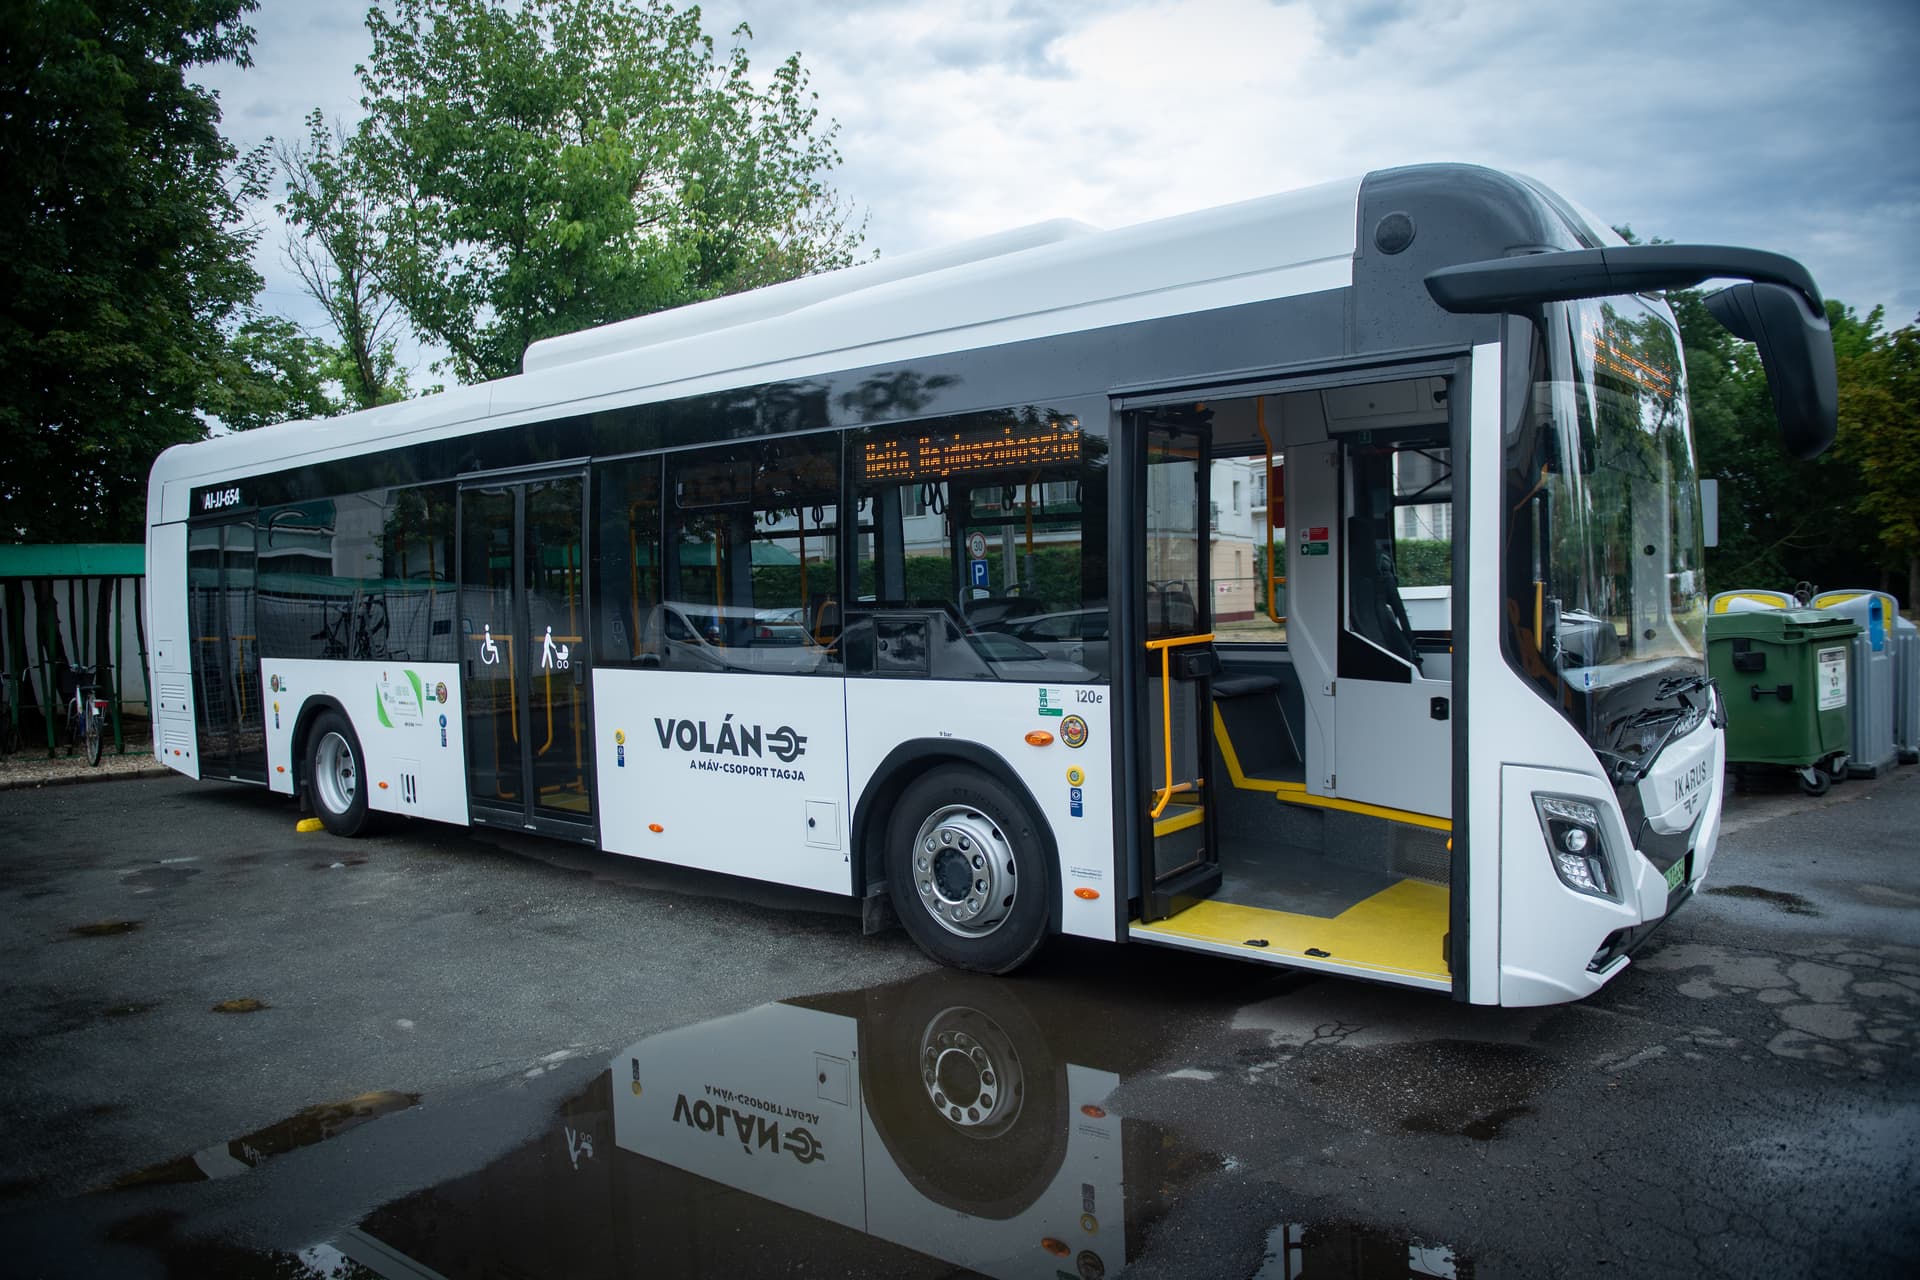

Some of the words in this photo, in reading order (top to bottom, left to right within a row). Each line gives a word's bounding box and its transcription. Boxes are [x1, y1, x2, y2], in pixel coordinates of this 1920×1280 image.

[204, 487, 240, 510] AI-JJ-654
[974, 541, 983, 552] 30
[975, 564, 984, 585] P
[1075, 689, 1103, 704] 120e
[654, 713, 762, 758] VOLÁN
[690, 760, 697, 770] A
[698, 758, 769, 778] MÁV-CSOPORT
[770, 767, 806, 782] TAGJA
[1674, 761, 1707, 802] IKARUS
